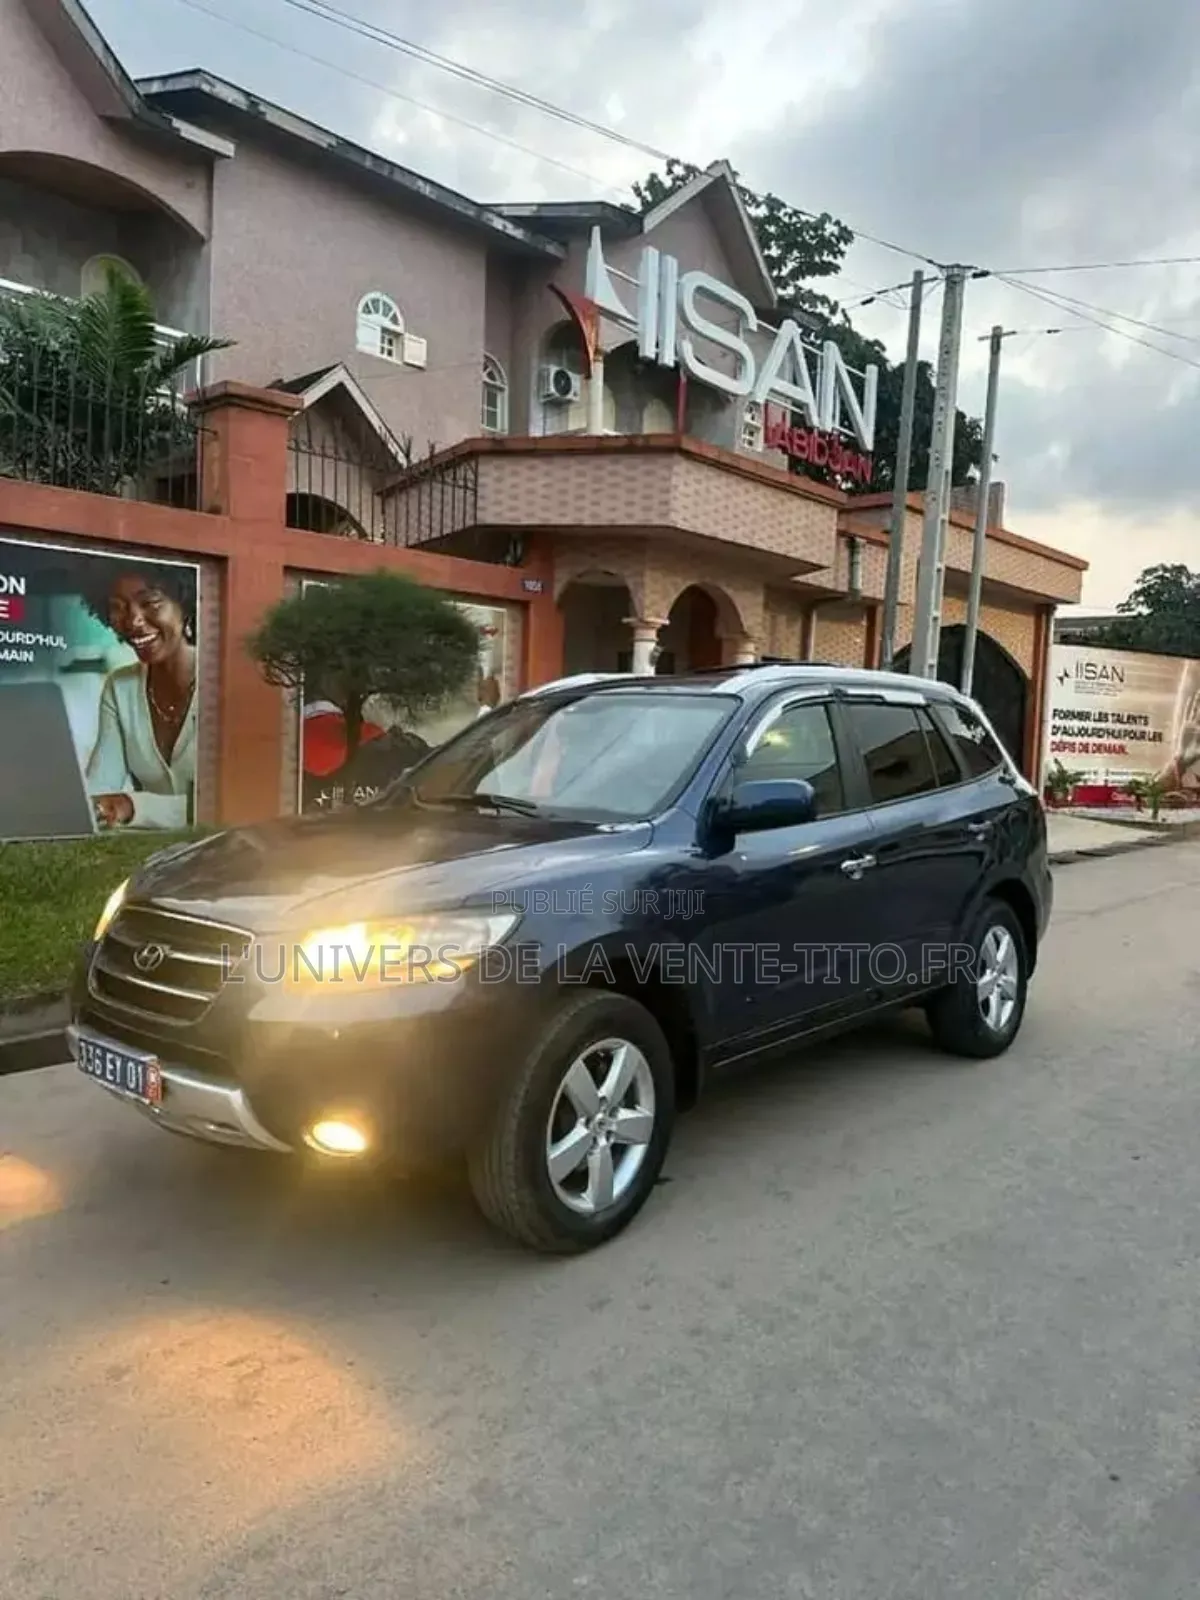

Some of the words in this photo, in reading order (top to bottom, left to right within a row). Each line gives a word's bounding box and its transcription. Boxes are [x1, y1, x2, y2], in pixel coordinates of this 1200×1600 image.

[1053, 708, 1092, 722] FORMER
[1093, 711, 1109, 723] LES
[1111, 712, 1149, 726] TALENTS
[1124, 729, 1147, 741] POUR
[1148, 731, 1163, 743] LES
[1078, 742, 1089, 753] DE
